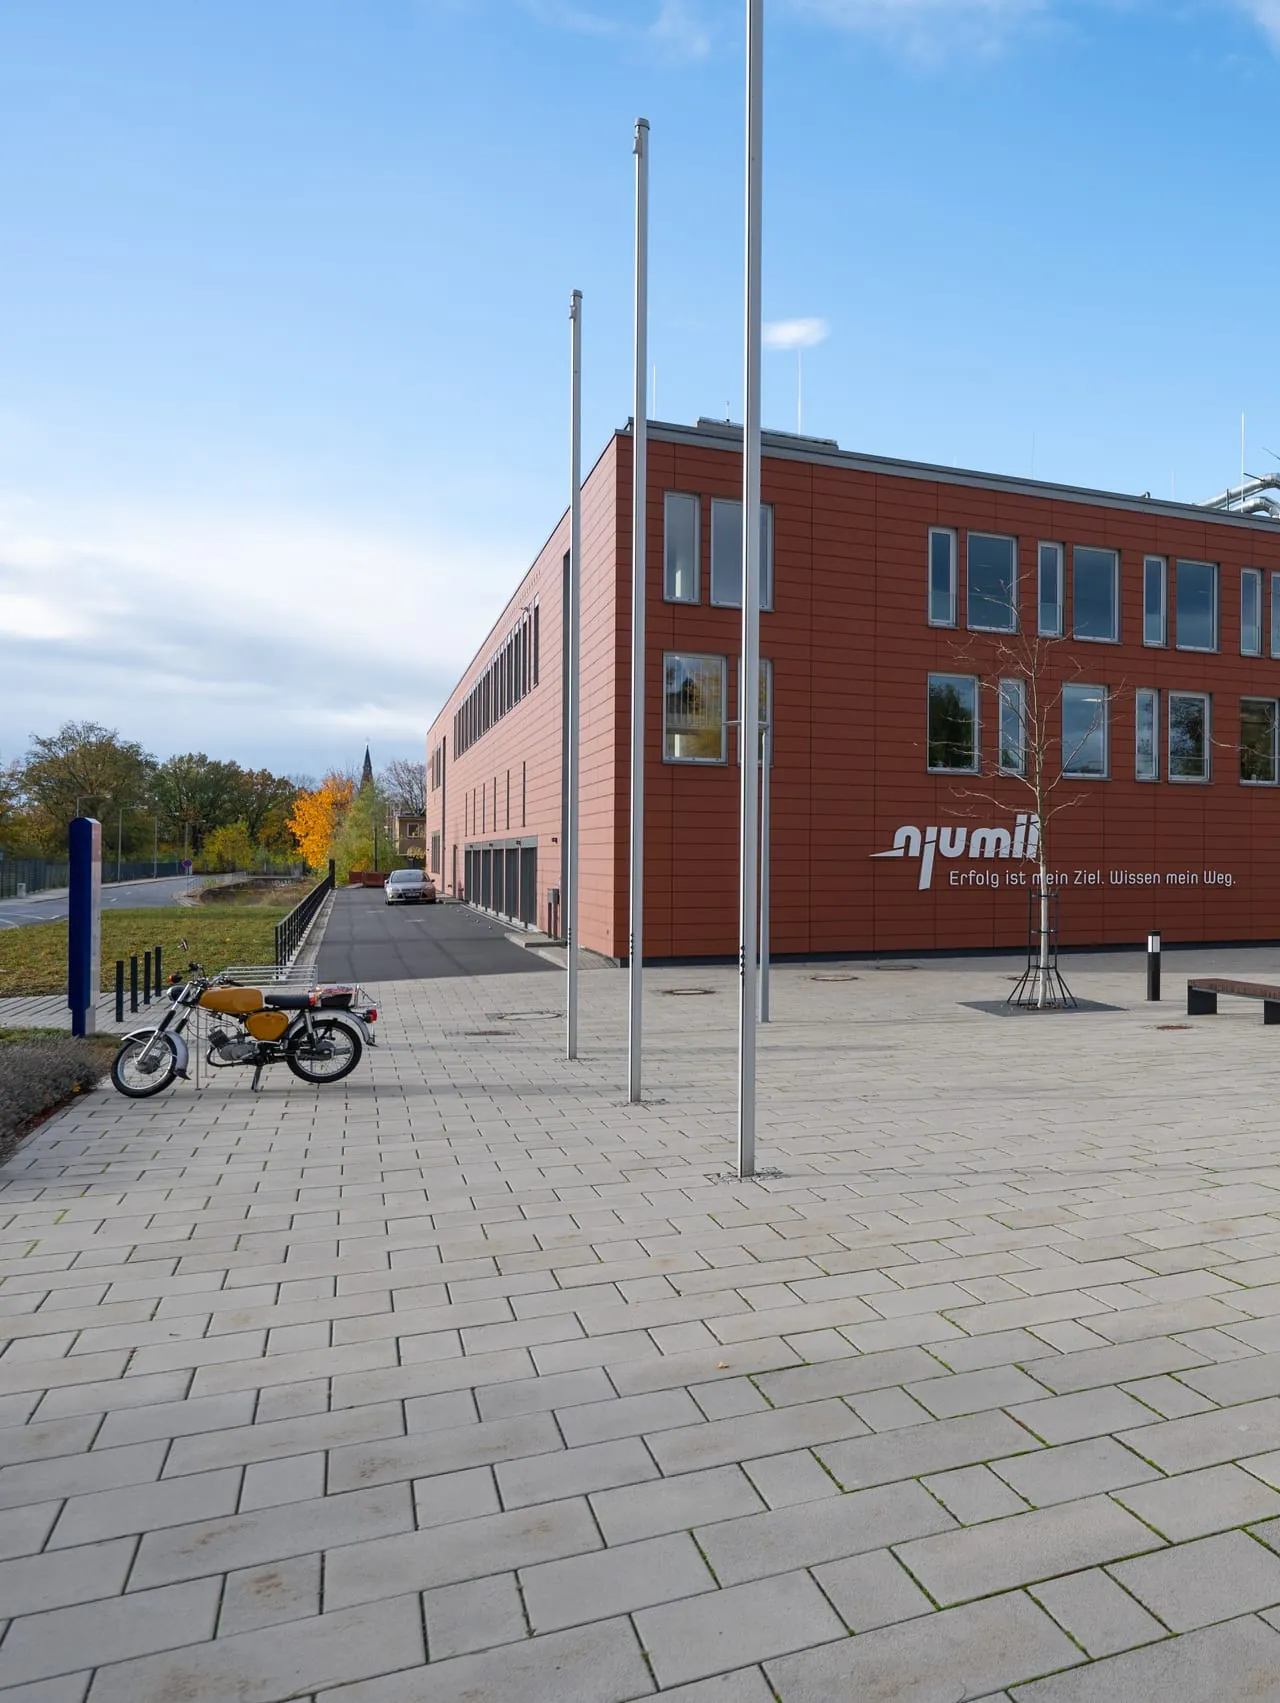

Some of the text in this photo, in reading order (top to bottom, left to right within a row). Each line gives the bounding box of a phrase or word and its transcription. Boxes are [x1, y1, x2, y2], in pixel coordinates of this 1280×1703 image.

[950, 870, 999, 888] Erfolg
[1006, 870, 1026, 885] ist
[1073, 870, 1105, 885] Ziel.
[1109, 870, 1161, 885] Wissen
[1166, 870, 1198, 885] mein
[1203, 870, 1236, 887] Weg.
